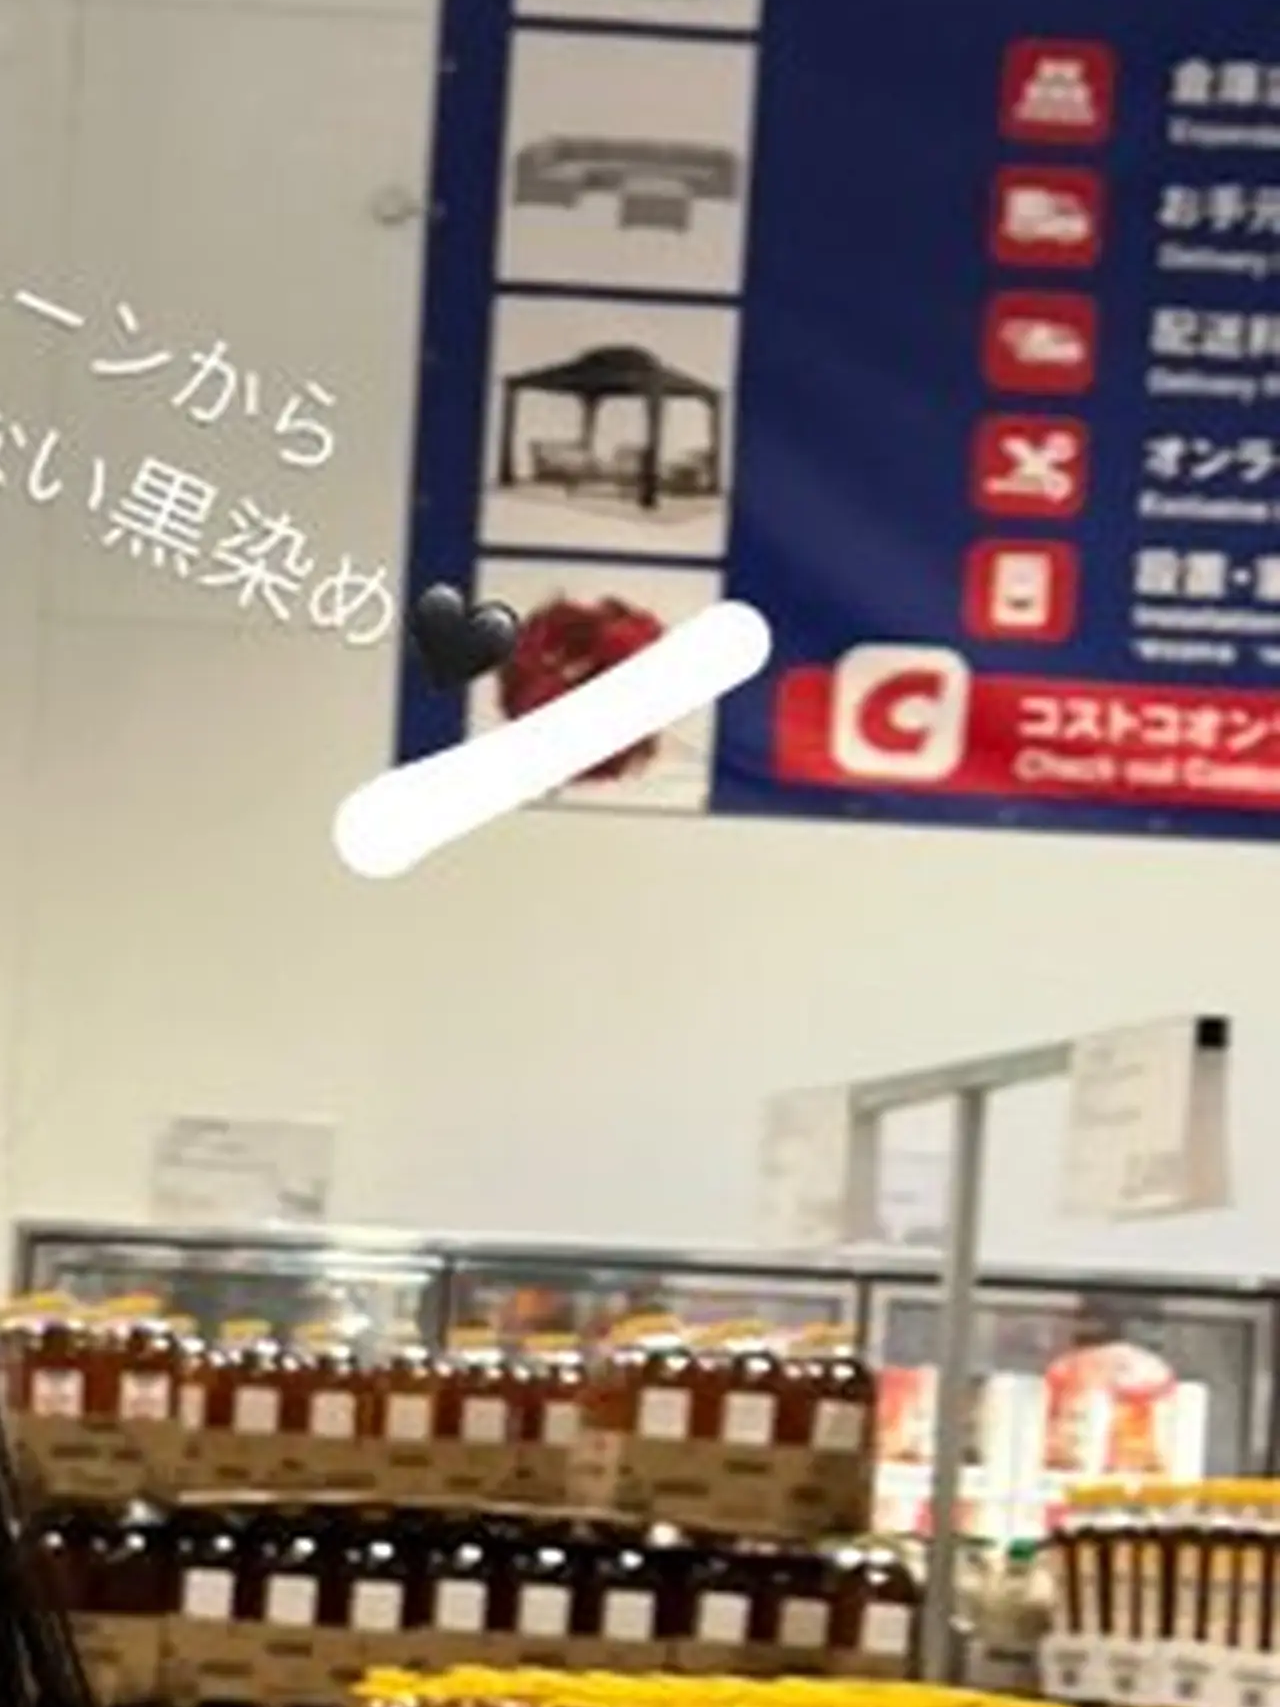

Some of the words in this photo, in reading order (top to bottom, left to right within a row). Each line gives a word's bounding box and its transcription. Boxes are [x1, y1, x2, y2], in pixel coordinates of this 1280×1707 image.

[1144, 435, 1280, 482] オンラ
[1018, 696, 1280, 752] コストコオン
